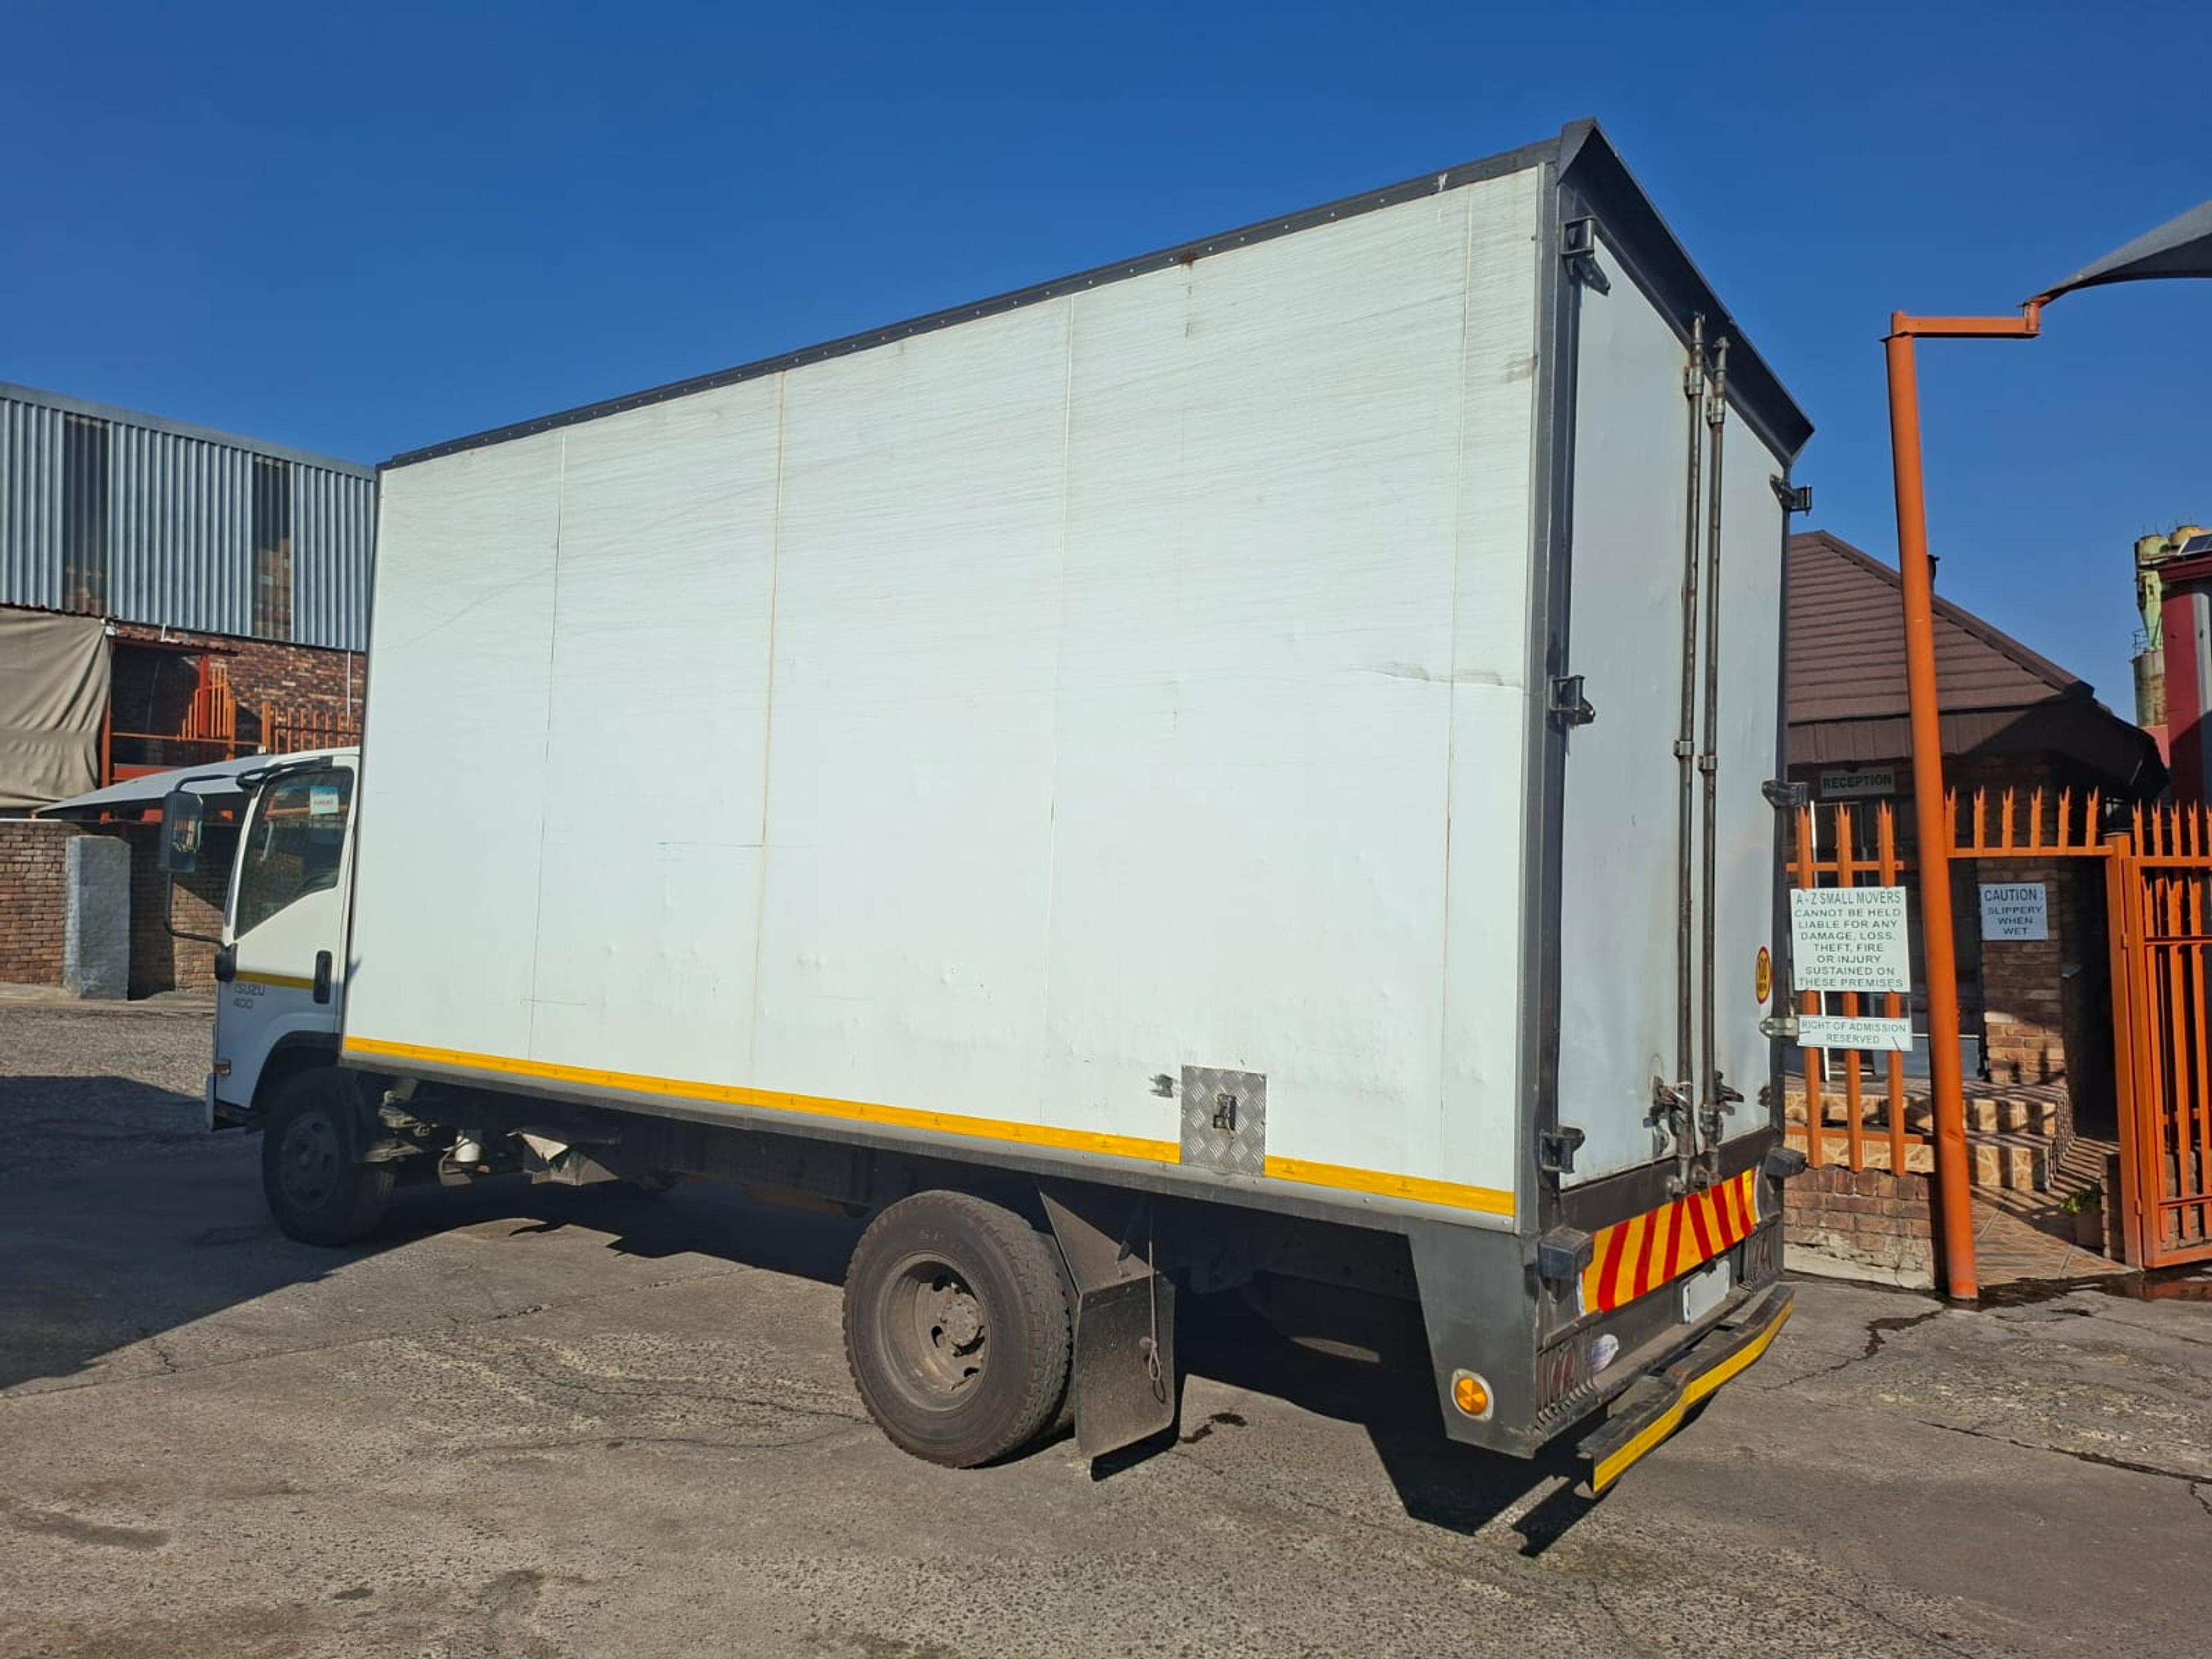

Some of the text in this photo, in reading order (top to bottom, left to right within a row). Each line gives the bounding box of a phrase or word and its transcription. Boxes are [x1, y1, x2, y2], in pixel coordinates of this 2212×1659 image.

[1824, 774, 1892, 789] RECEPTION
[1819, 893, 1854, 905] SMALL
[1857, 892, 1901, 904] MOVERS
[1794, 908, 1901, 918] CANNOT BE HELD
[1987, 906, 2043, 915] SLIPPERY
[1798, 920, 1897, 929] LIABLE FOR ANY
[1998, 916, 2033, 925] WHEN
[2003, 927, 2027, 935] WET
[1814, 943, 1884, 953] THEFT, FIRE
[1816, 955, 1881, 963] OR INJURY
[1805, 966, 1895, 975] SUSTAINED ON
[1800, 978, 1903, 987] THESE PREMISES
[1801, 1020, 1906, 1032] RIGHT OF ADMISSION
[1826, 1033, 1880, 1044] RESERVED
